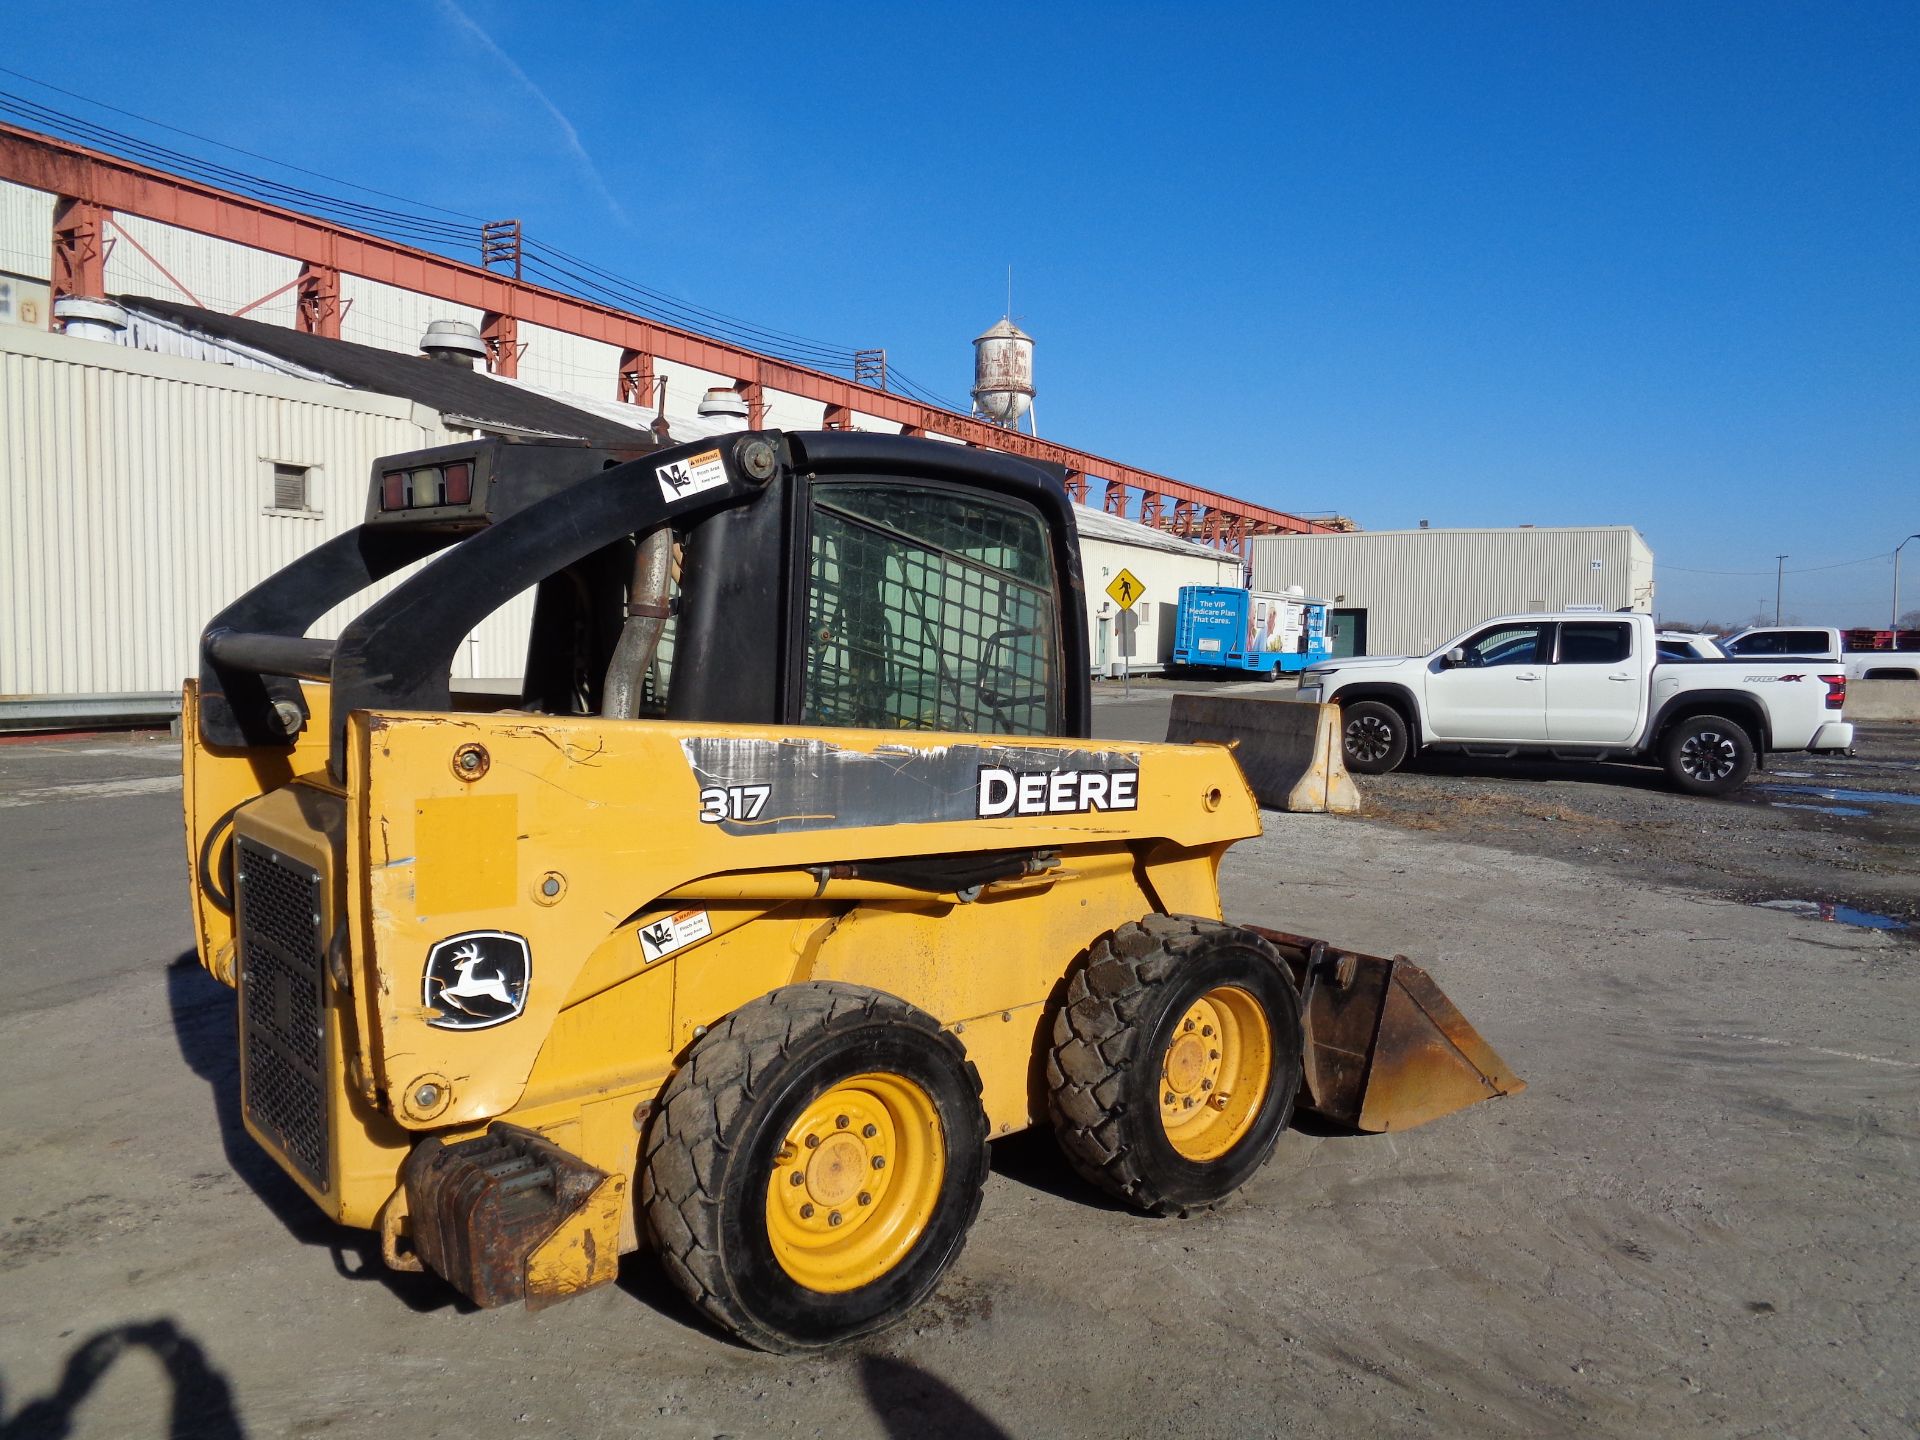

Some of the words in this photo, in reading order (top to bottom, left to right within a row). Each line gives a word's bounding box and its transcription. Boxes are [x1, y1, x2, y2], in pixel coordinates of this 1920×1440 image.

[695, 453, 718, 464] WARNING
[1189, 608, 1220, 616] Medicare
[978, 767, 1137, 816] DEERE
[701, 785, 771, 823] 317
